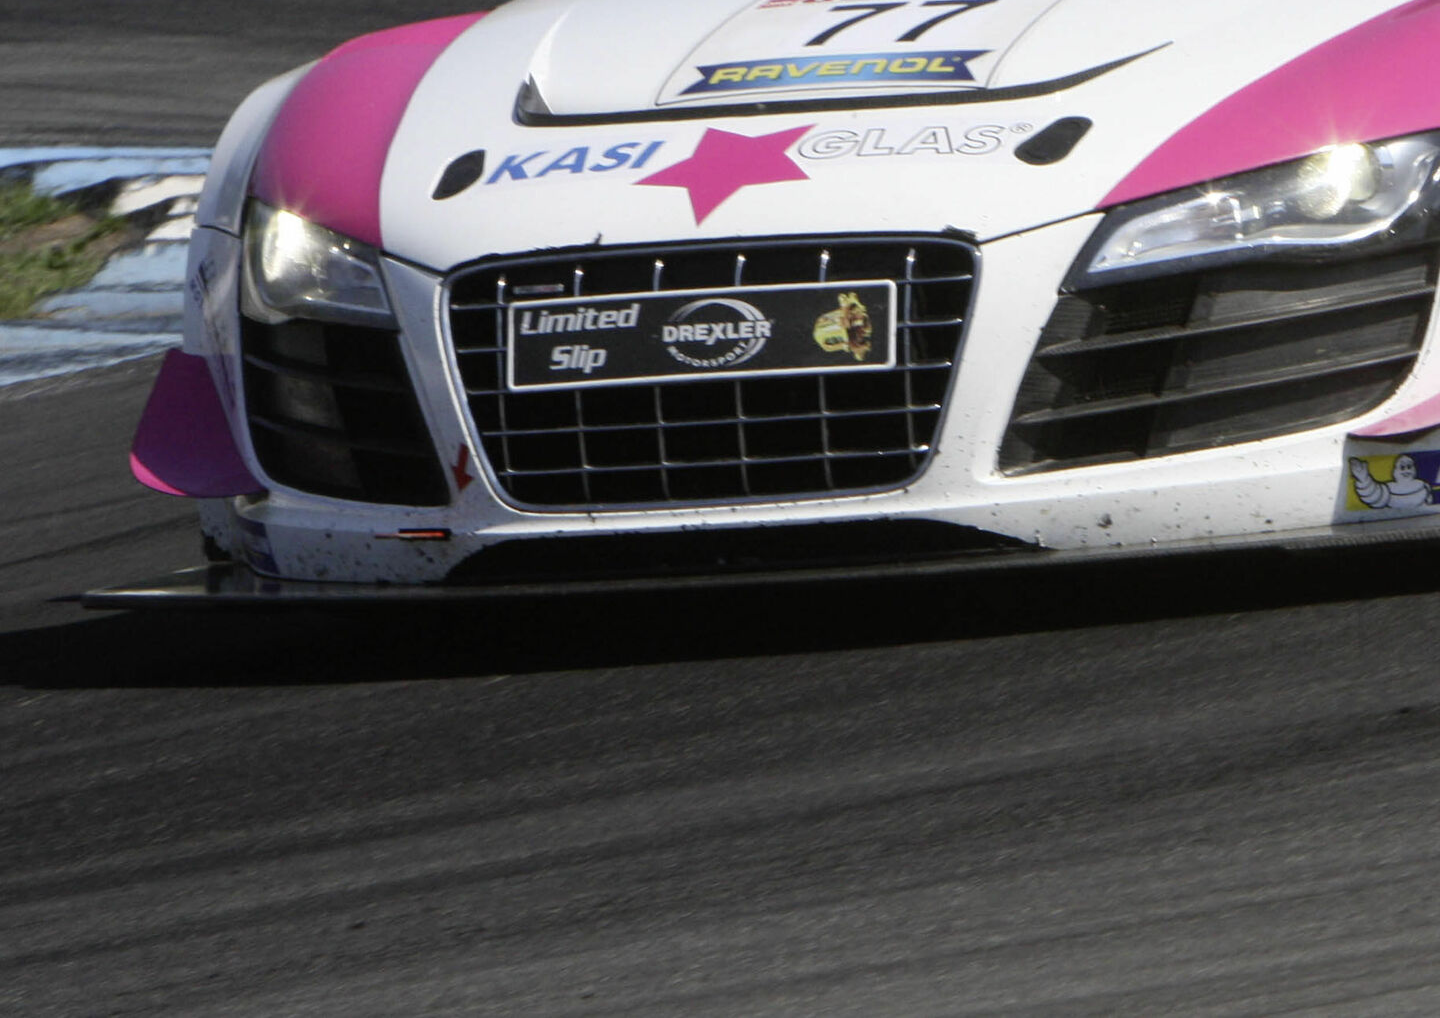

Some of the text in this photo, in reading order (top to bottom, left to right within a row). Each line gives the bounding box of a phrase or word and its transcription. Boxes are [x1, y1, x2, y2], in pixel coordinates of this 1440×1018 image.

[708, 57, 956, 84] RAVENOL
[486, 140, 666, 185] KASI
[519, 303, 641, 335] Limited
[661, 321, 772, 345] DREXLER
[549, 345, 607, 374] Slip
